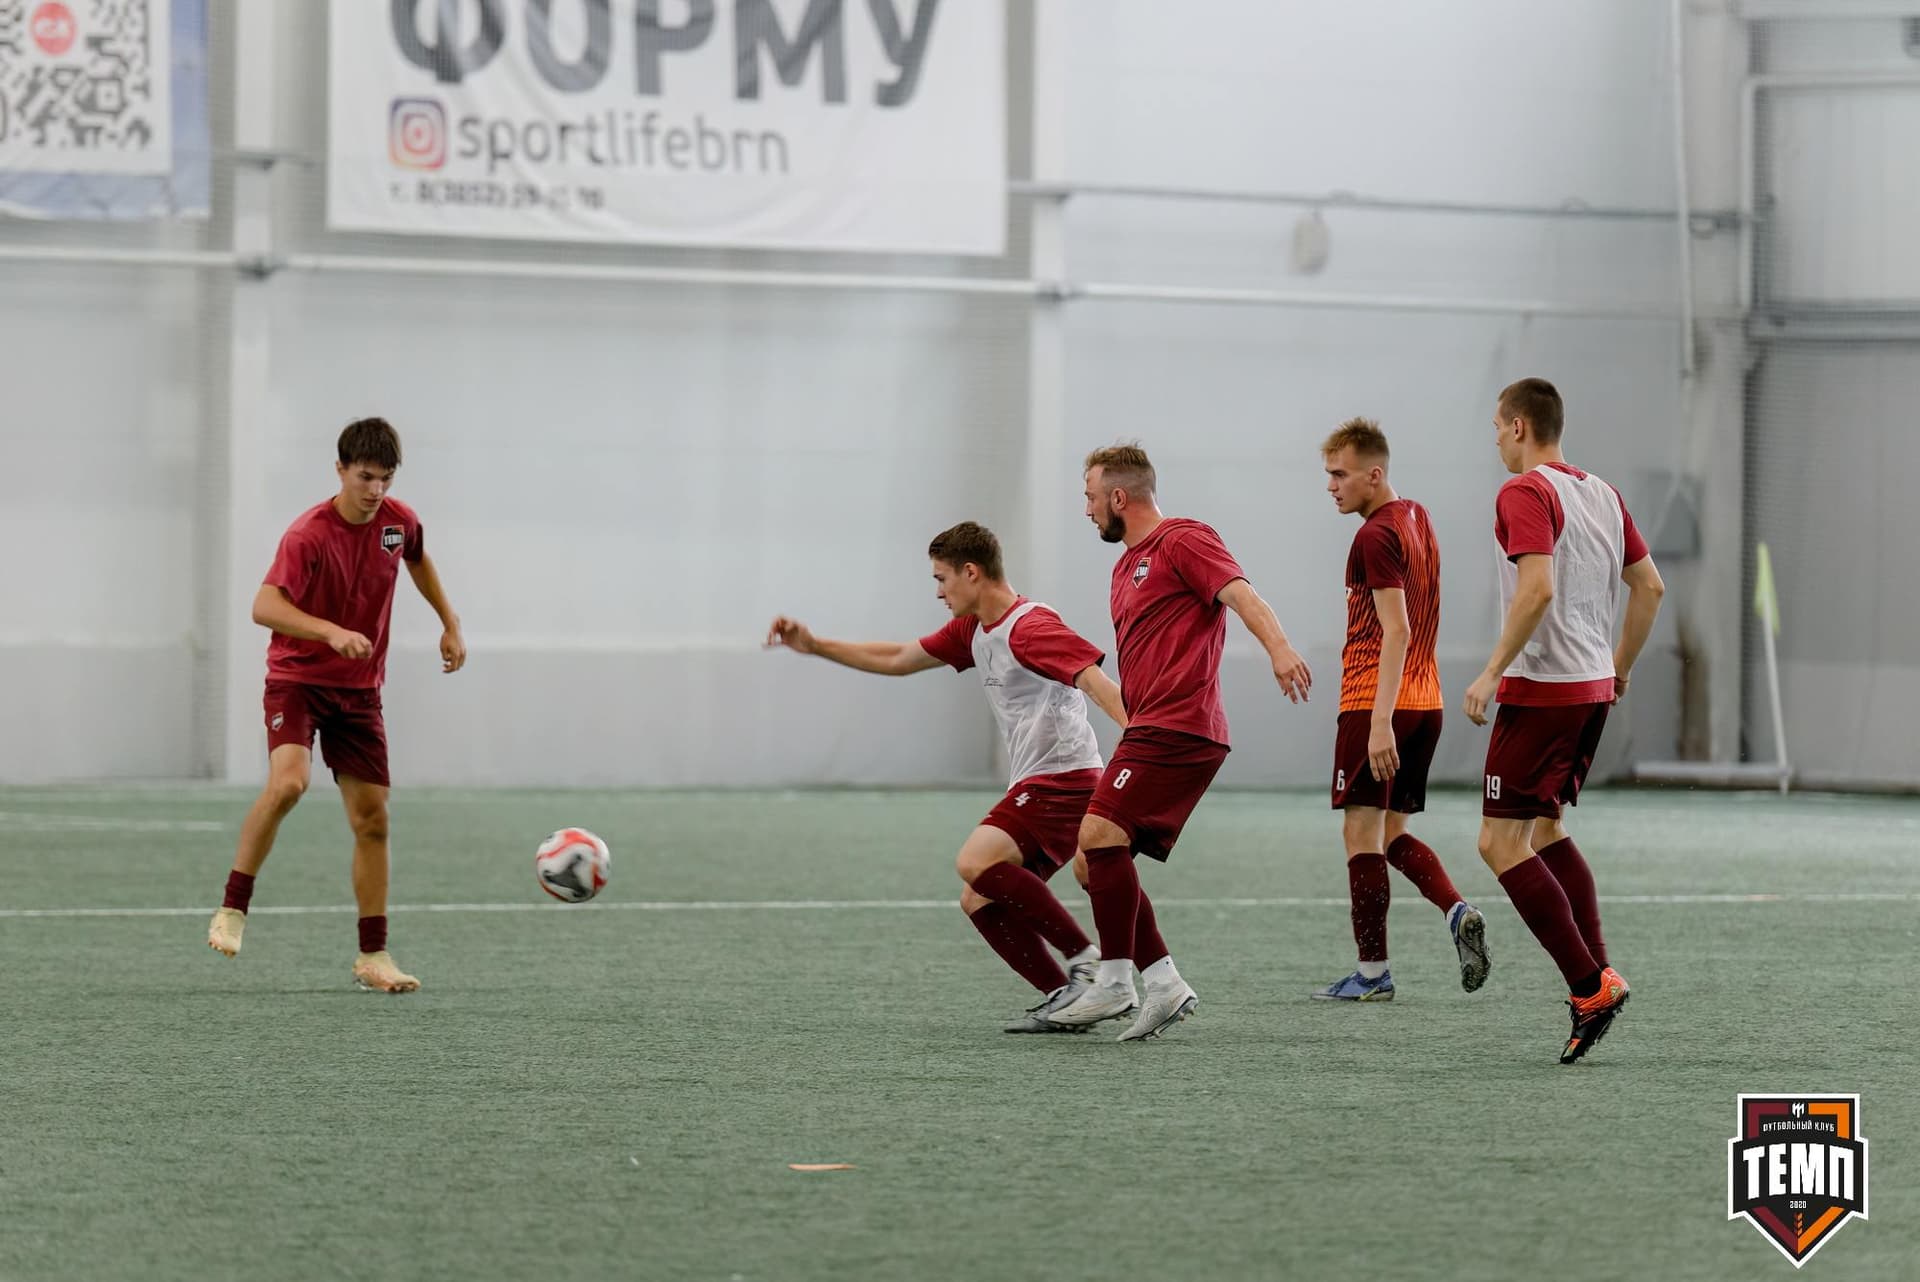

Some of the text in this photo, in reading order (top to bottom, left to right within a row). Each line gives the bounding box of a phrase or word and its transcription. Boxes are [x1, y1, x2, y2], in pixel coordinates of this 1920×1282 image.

[390, 0, 942, 108] ФОРМУ
[456, 109, 790, 173] sportlifebrn
[1113, 768, 1132, 790] 8
[1336, 769, 1346, 791] 6
[1486, 774, 1501, 800] 19
[1014, 792, 1031, 807] 4
